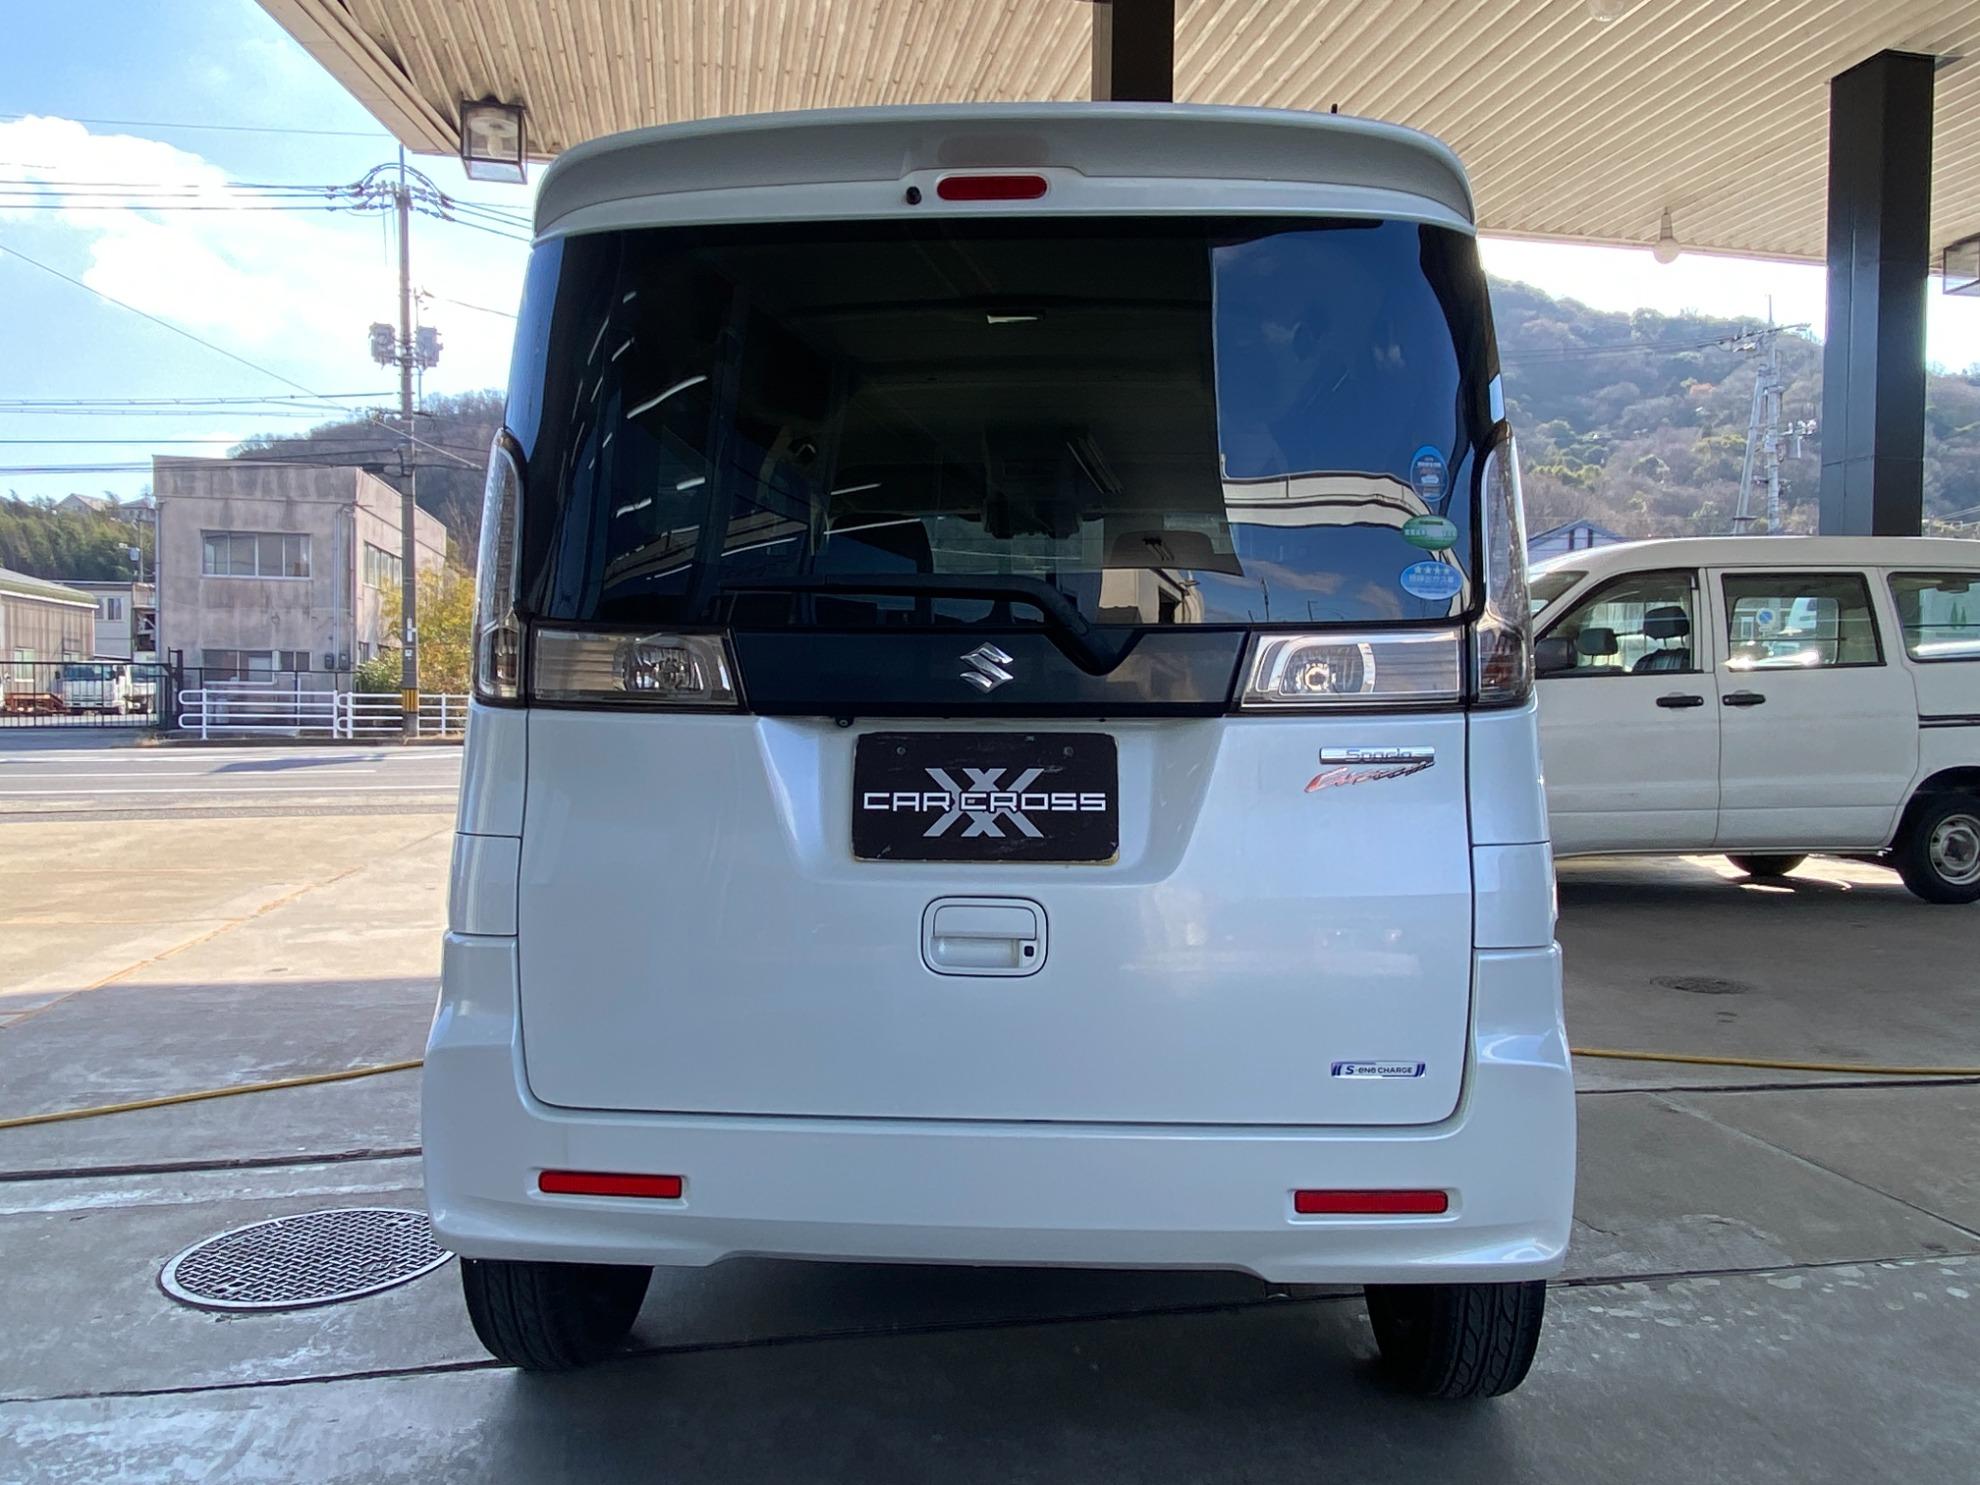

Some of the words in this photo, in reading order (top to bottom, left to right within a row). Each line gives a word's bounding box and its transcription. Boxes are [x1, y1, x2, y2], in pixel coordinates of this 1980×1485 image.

[863, 792, 951, 812] CAR
[960, 792, 1107, 812] CROSS
[1377, 1066, 1413, 1074] CHARGE
